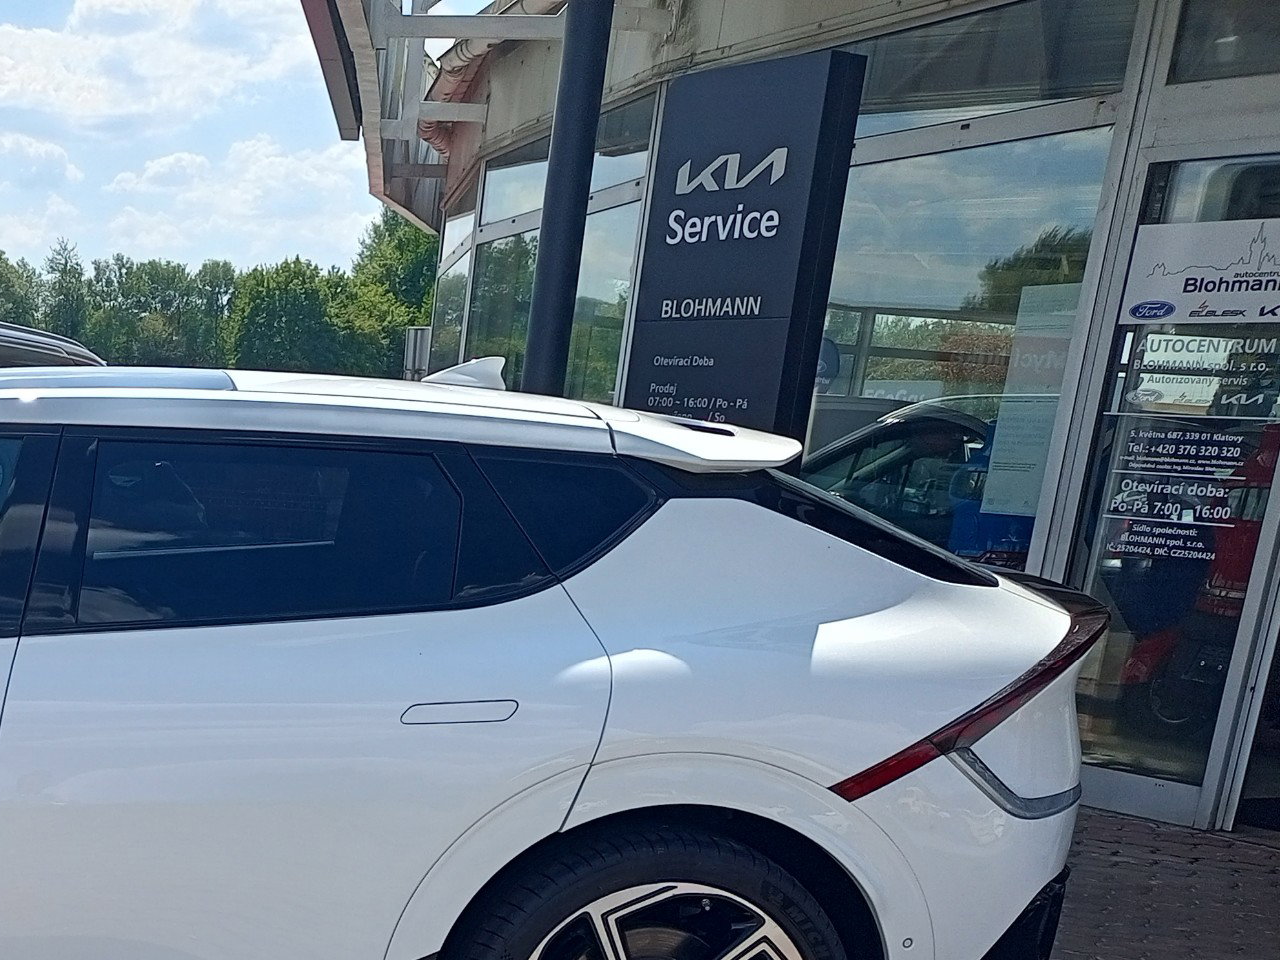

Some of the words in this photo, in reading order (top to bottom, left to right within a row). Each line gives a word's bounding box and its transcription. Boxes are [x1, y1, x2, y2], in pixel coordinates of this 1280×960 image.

[675, 147, 788, 195] KIA
[665, 203, 779, 245] Service
[1182, 277, 1280, 294] Blohman
[661, 296, 761, 318] BLOHMANN
[1134, 302, 1170, 318] Ford
[1136, 338, 1277, 354] AUTOCENTRUM
[654, 356, 692, 366] Otevírací
[692, 356, 714, 366] Doba
[1133, 359, 1204, 371] BLOHMANN
[1207, 361, 1236, 373] spol.
[1250, 362, 1269, 371] r.o.
[1216, 374, 1248, 386] servis
[650, 383, 677, 395] Prodej
[648, 397, 673, 406] 07:00
[684, 397, 708, 408] 16:00
[716, 399, 728, 408] Po
[736, 399, 748, 409] Pá
[1220, 393, 1264, 405] KIA
[714, 412, 725, 422] So
[1185, 432, 1199, 440] 339
[1213, 434, 1244, 443] Klatovy
[1178, 444, 1196, 455] 376
[1198, 446, 1218, 456] 320
[1220, 447, 1240, 457] 320
[1121, 479, 1185, 495] Otevírací
[1187, 483, 1229, 497] doba:
[1110, 499, 1149, 513] Po-Pá
[1153, 502, 1180, 515] 7:00
[1194, 505, 1231, 519] 16:00
[1132, 524, 1150, 532] Sídlo
